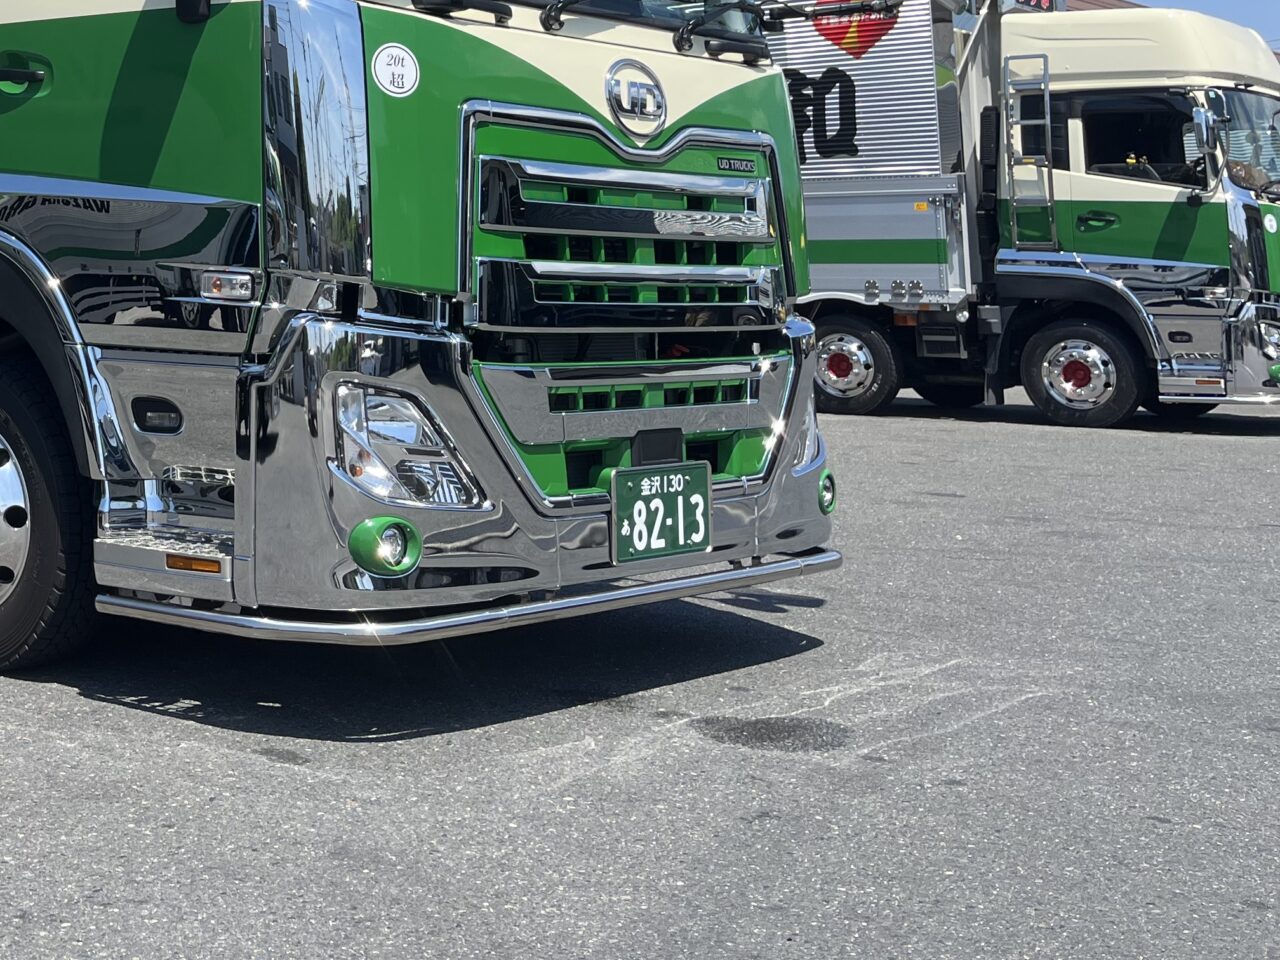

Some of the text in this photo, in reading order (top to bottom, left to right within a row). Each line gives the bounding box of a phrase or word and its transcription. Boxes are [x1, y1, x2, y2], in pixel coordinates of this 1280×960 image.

[386, 53, 406, 68] 20t
[389, 71, 406, 89] 超
[608, 78, 663, 121] UD
[718, 158, 756, 171] UD TRUCKS
[620, 518, 631, 536] あ
